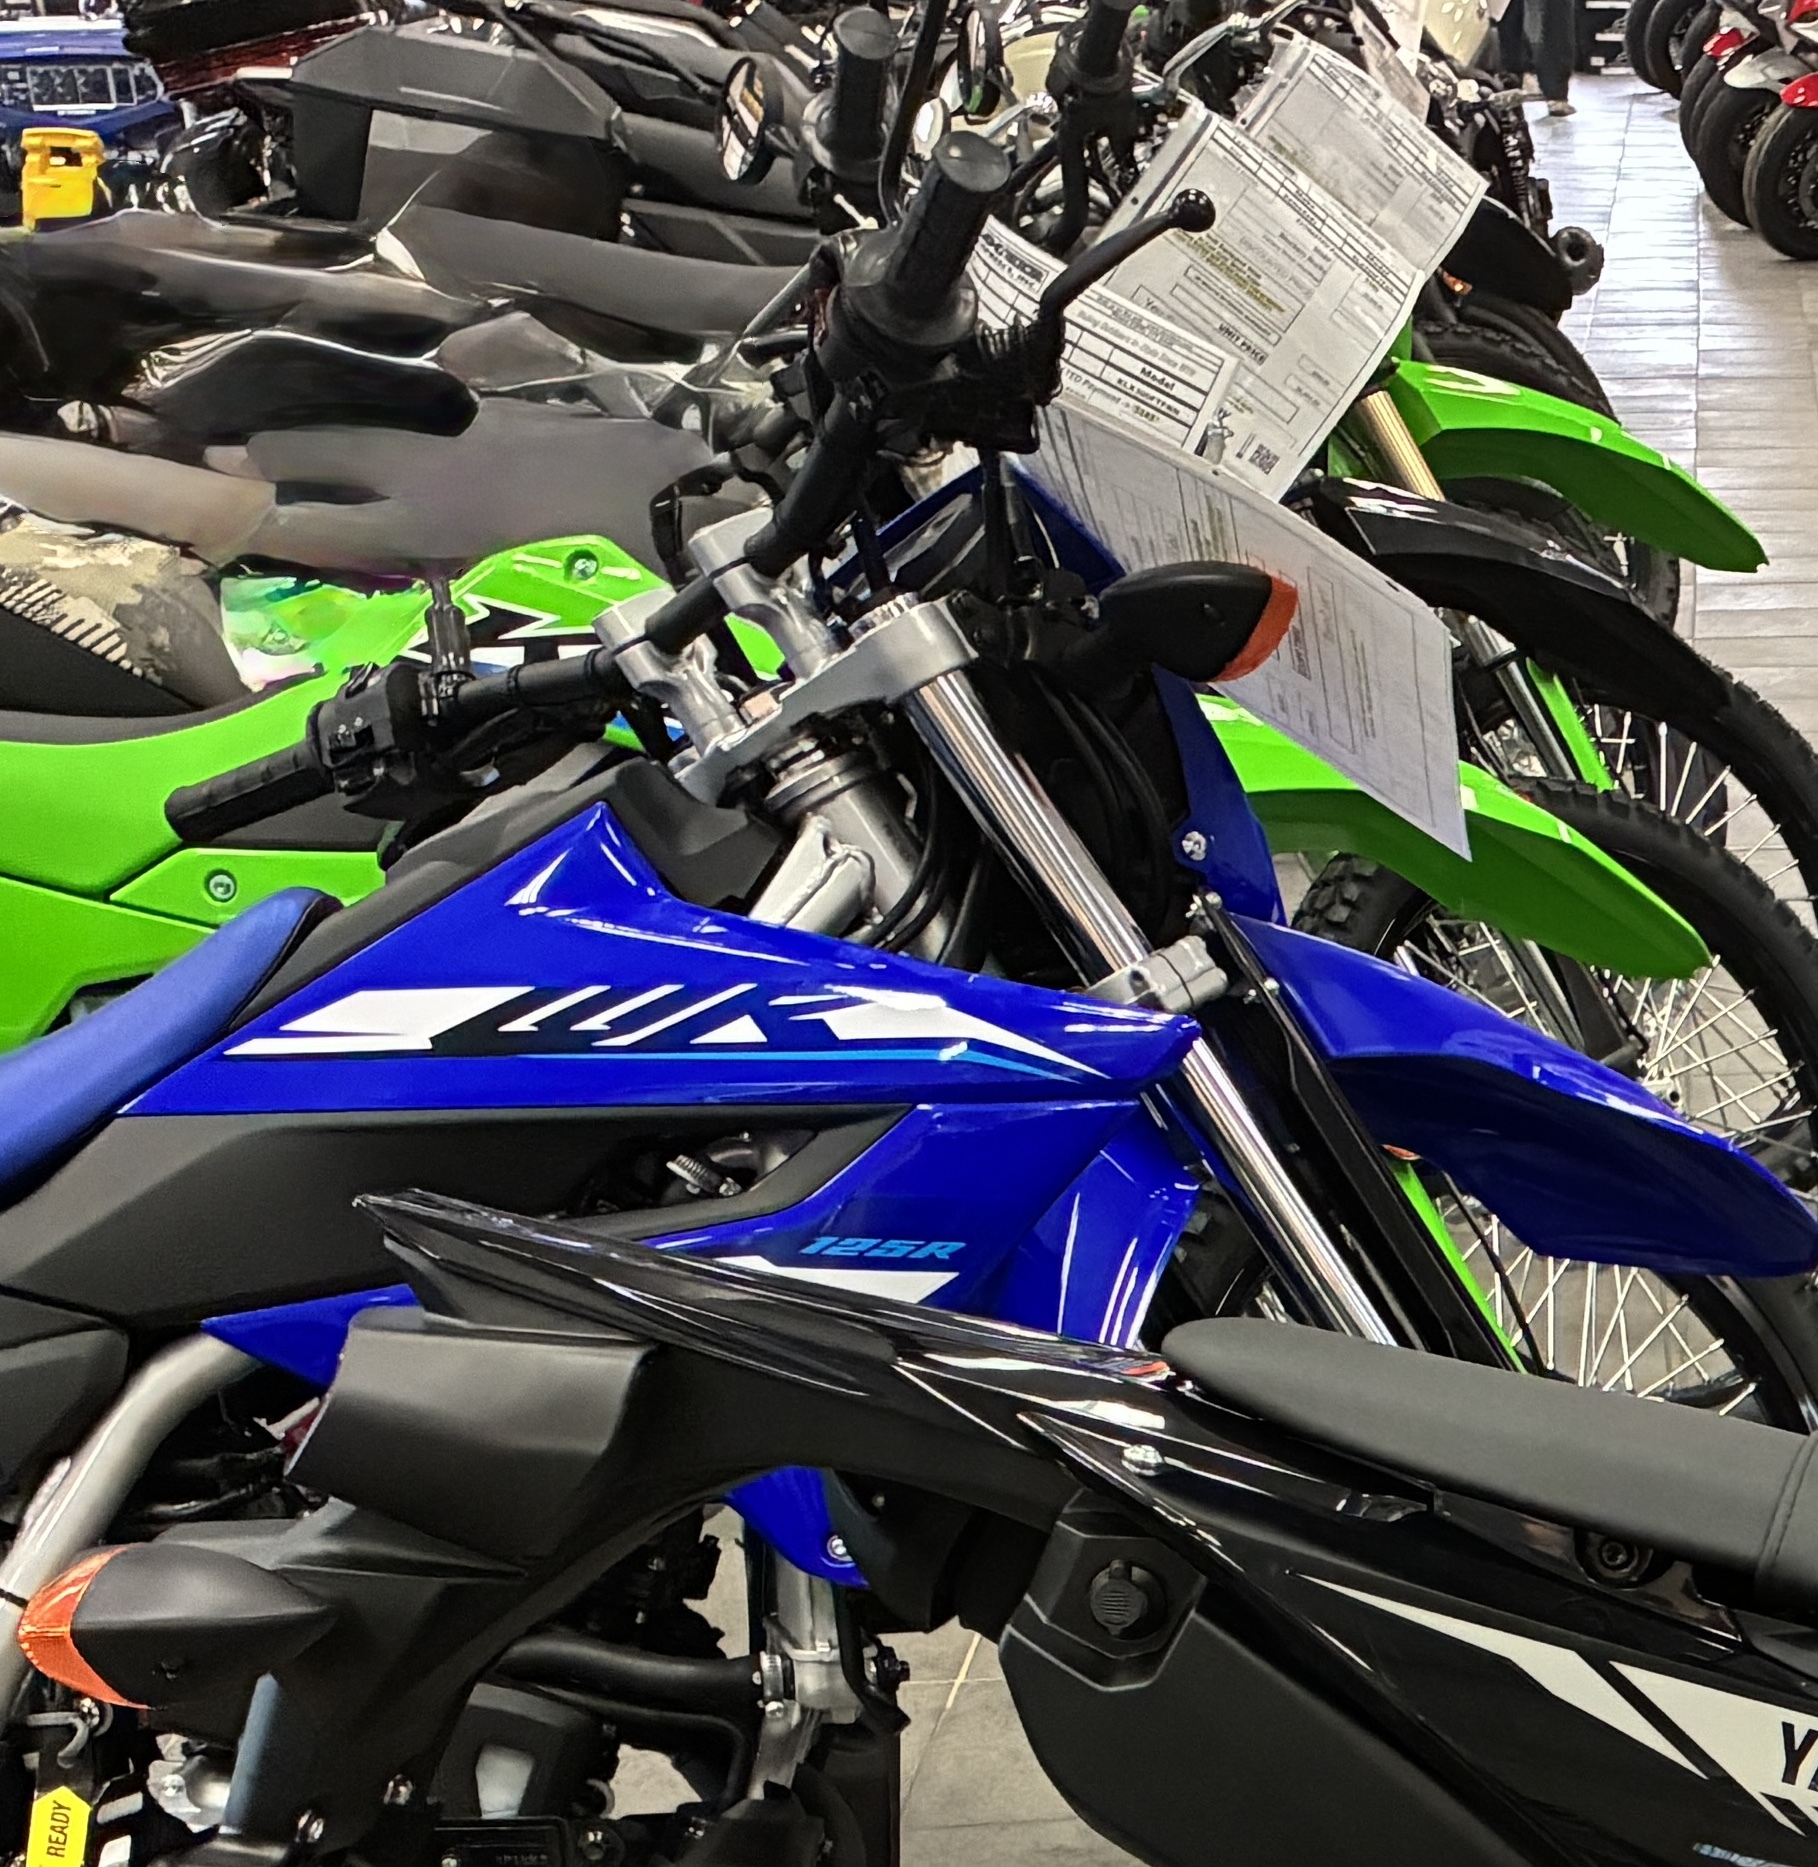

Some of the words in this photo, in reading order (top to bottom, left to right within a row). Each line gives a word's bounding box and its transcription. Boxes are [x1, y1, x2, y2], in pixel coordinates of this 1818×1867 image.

[1138, 366, 1176, 391] Model
[801, 1236, 967, 1261] 125R
[46, 1799, 72, 1859] READY
